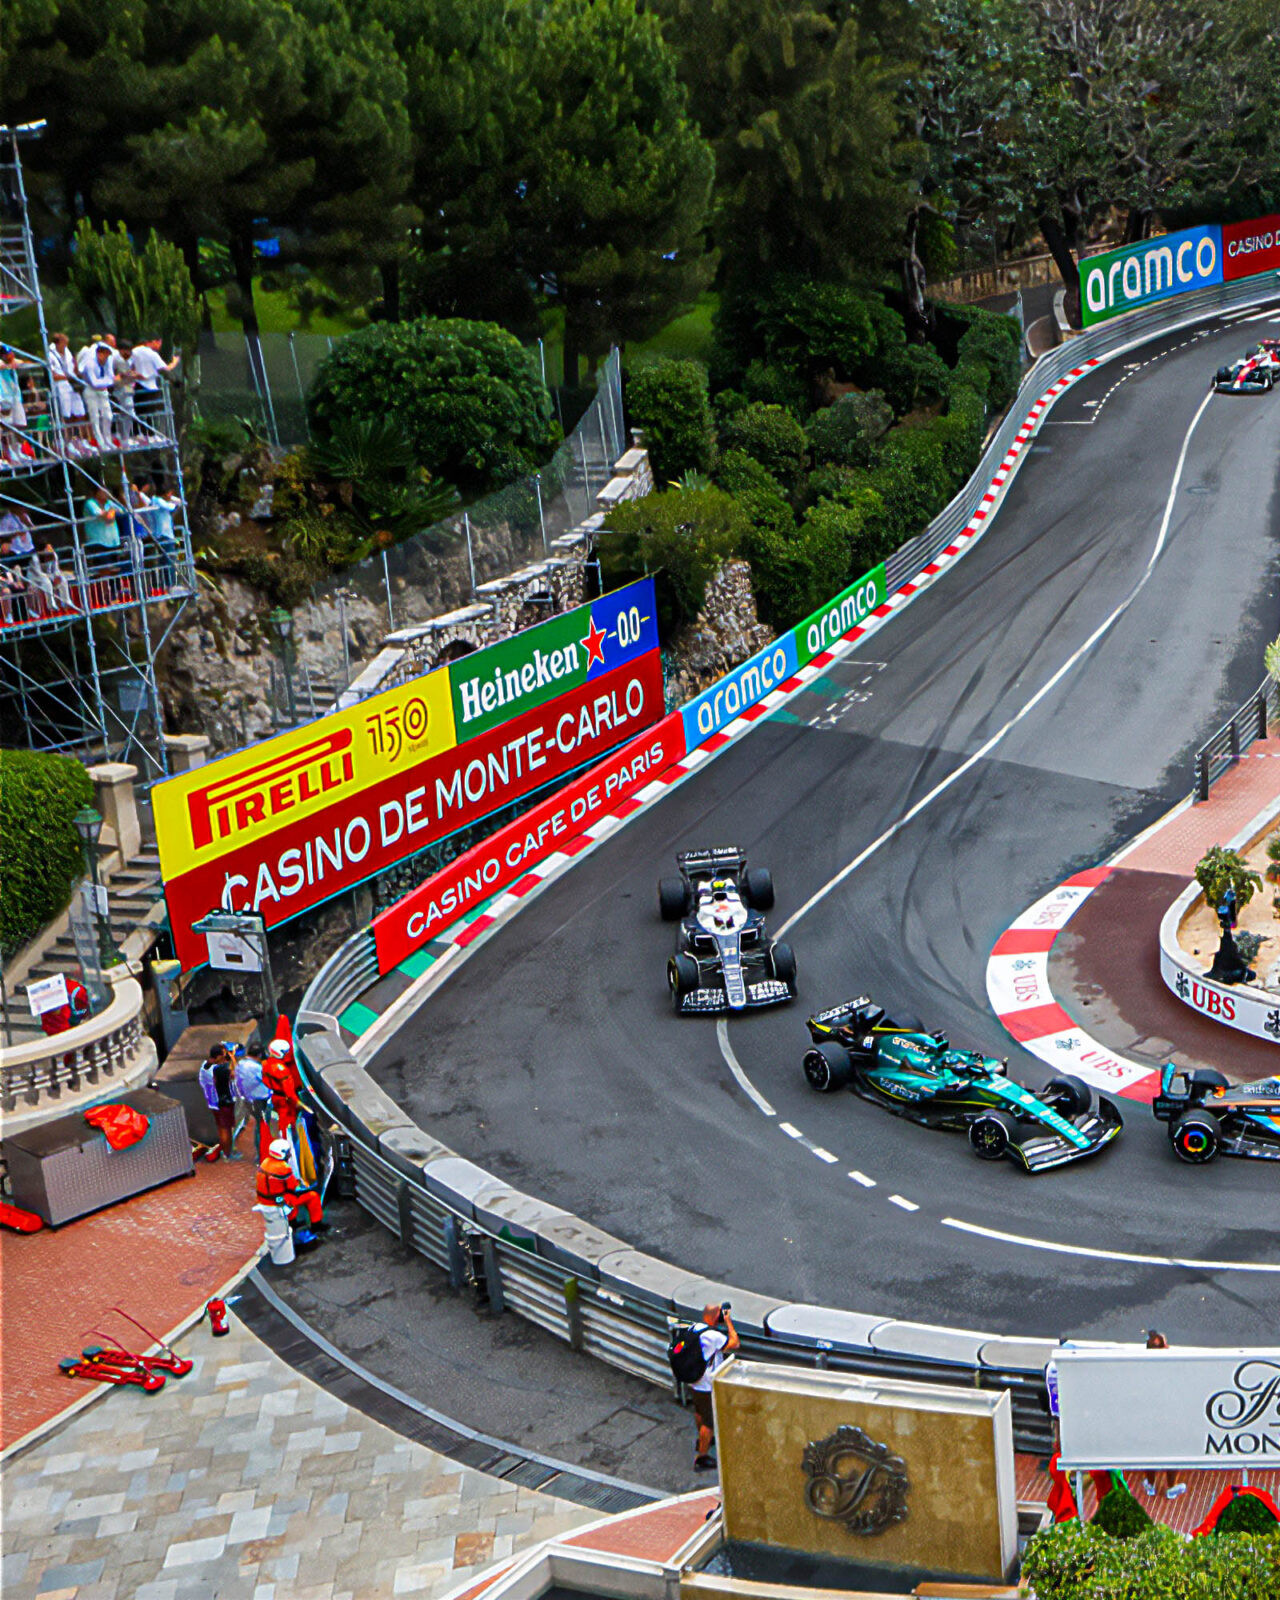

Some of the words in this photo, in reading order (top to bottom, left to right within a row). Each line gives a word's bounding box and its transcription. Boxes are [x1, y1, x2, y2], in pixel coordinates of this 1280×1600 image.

[1087, 237, 1216, 312] aramco
[1228, 233, 1272, 257] CASINO
[807, 580, 876, 653] aramco
[459, 641, 580, 723] Heineken
[697, 648, 786, 734] aramco
[187, 727, 354, 851] PIRELLI
[222, 817, 371, 914] CASINO
[380, 787, 429, 847] DE
[435, 679, 645, 818] MONTE-CARLO
[406, 861, 500, 938] CASINO
[506, 817, 567, 868] CAFE
[571, 792, 601, 823] DE
[606, 741, 664, 797] PARIS
[1013, 974, 1040, 1002] UBS
[1192, 982, 1235, 1021] UBS
[1079, 1051, 1126, 1078] UBS
